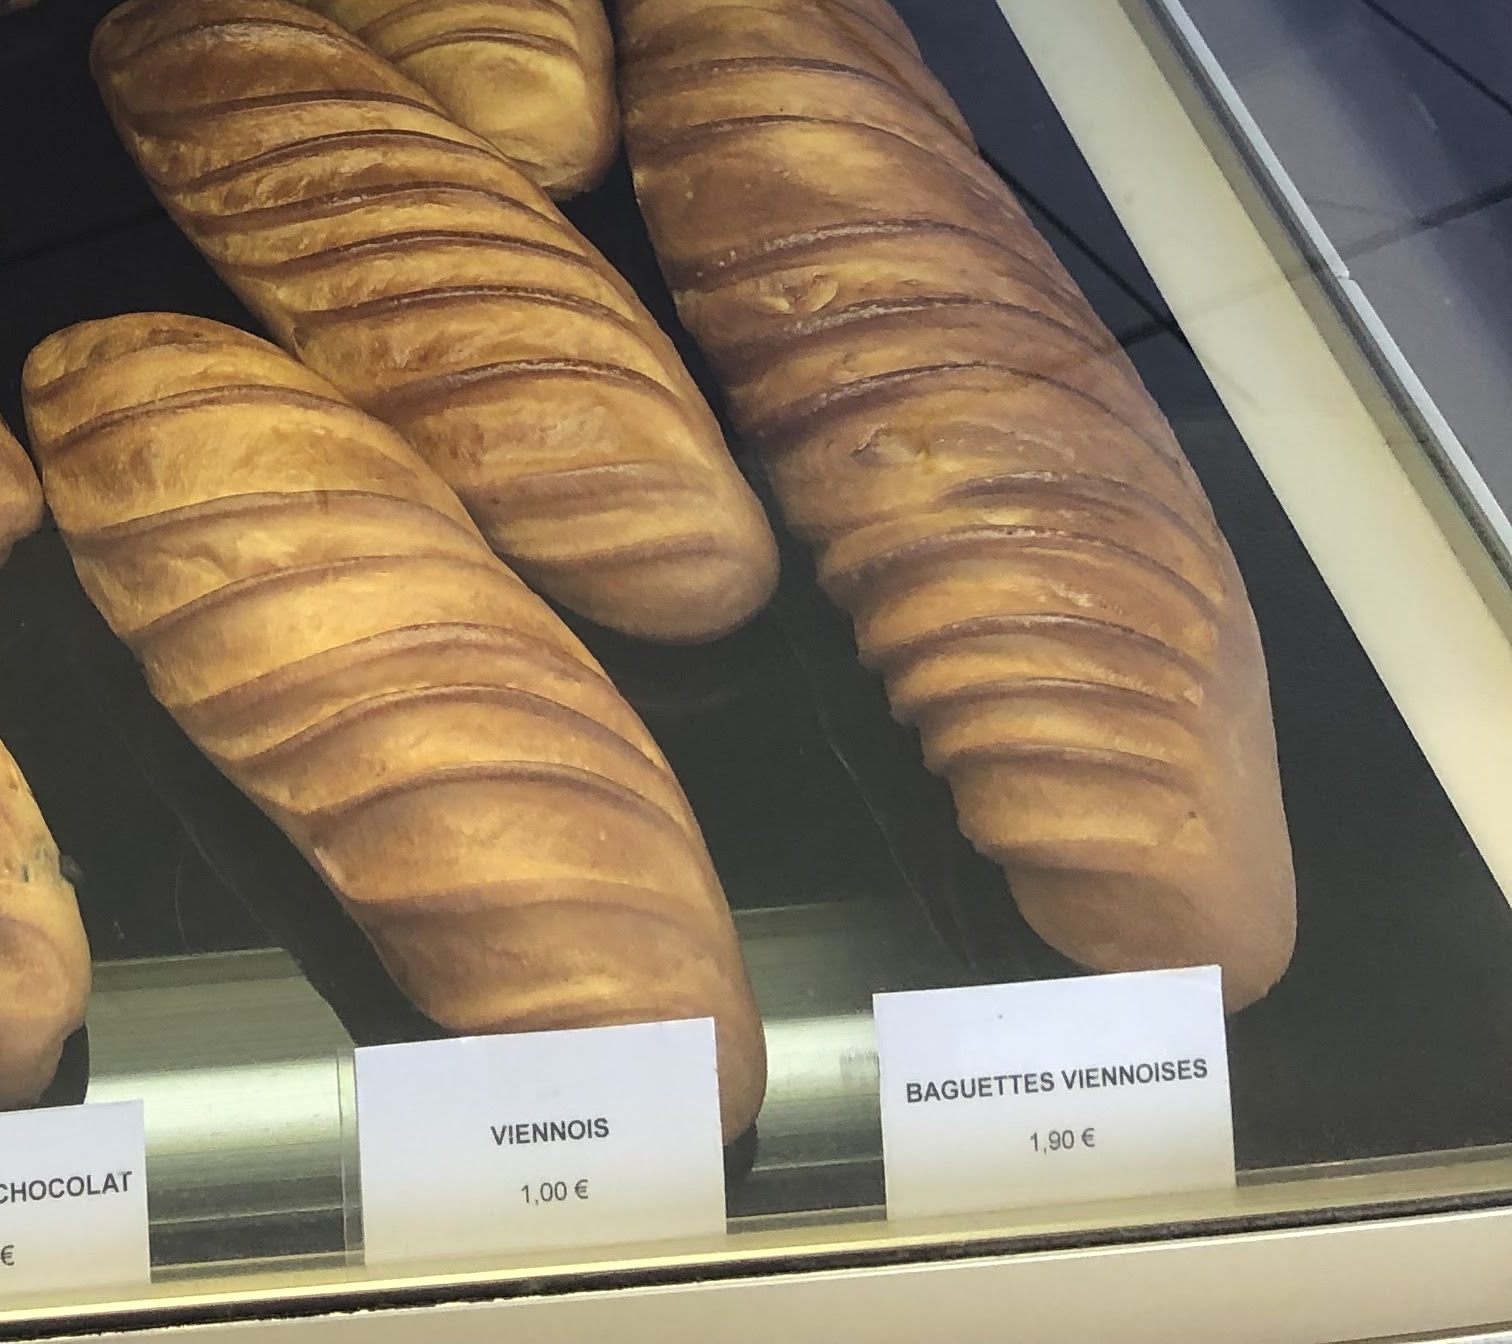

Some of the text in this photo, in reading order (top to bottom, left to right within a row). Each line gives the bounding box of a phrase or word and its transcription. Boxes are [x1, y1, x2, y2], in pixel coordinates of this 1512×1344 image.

[906, 1058, 1208, 1104] BAGUETTES VIENNOISES
[490, 1117, 610, 1146] VIENNOIS
[1029, 1127, 1096, 1155] 1,90 €
[520, 1178, 589, 1206] 1,00 €
[0, 1244, 15, 1267] €
